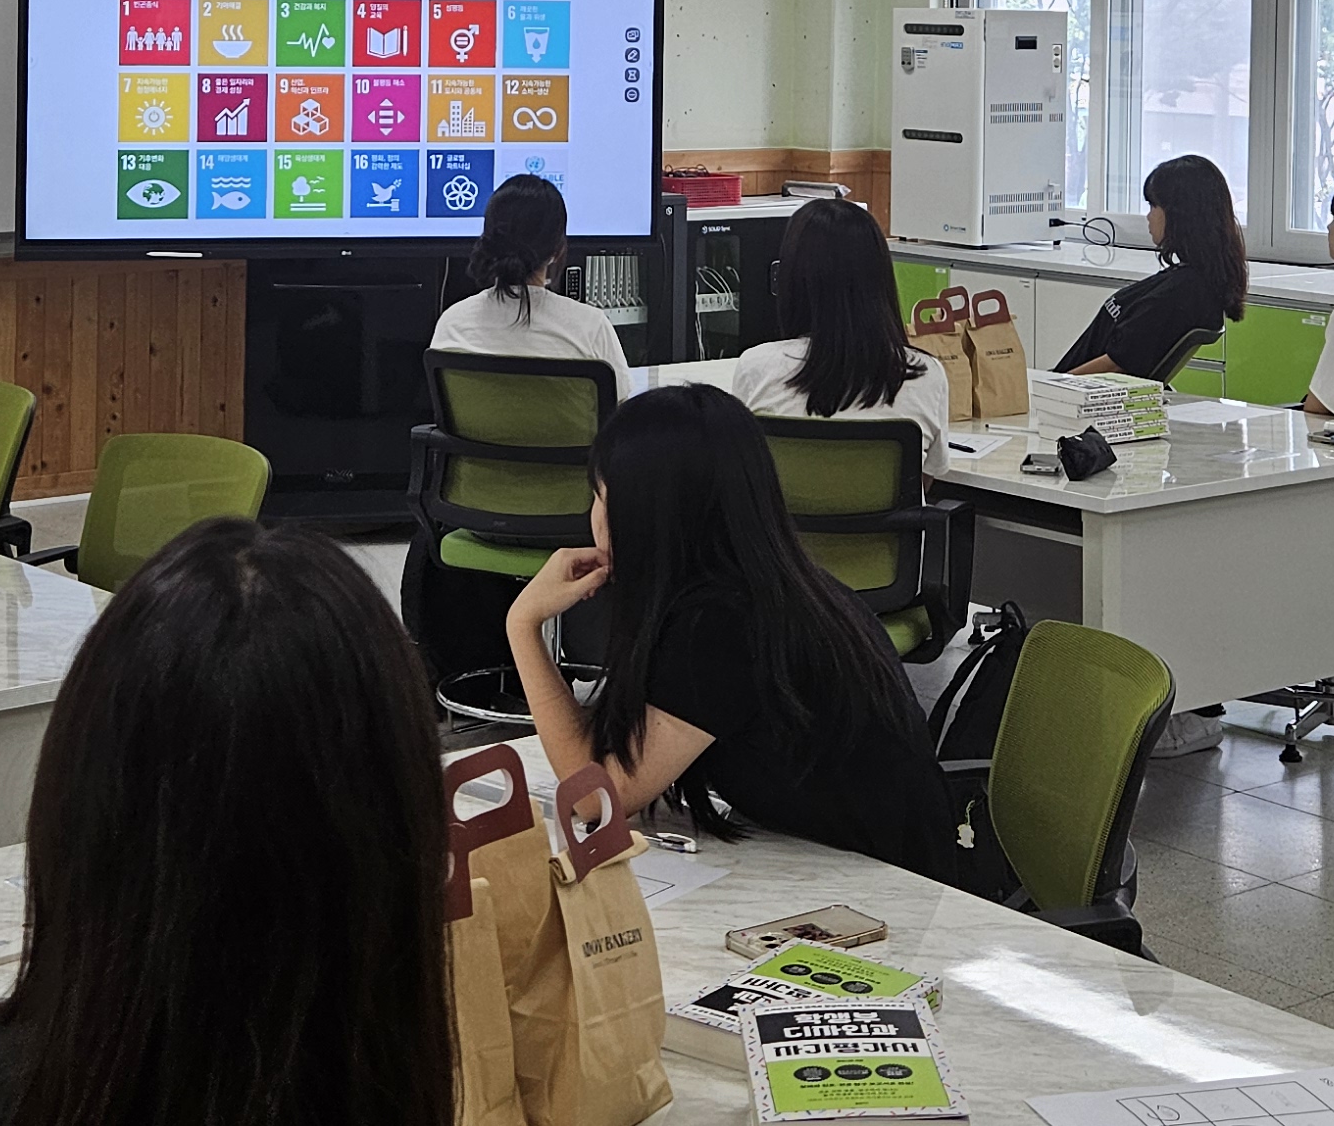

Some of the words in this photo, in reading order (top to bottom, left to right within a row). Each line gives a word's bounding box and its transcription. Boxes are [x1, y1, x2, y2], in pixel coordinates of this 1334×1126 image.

[122, 0, 130, 16] 1
[203, 1, 212, 17] 2
[280, 2, 290, 18] 3
[356, 3, 367, 19] 4
[433, 4, 442, 20] 5
[507, 5, 516, 20] 6
[123, 78, 132, 93] 7
[202, 78, 211, 93] 8
[279, 78, 289, 94] 9
[355, 79, 370, 94] 10
[431, 79, 442, 94] 11
[505, 80, 519, 95] 12
[121, 154, 136, 170] 13
[199, 155, 214, 170] 14
[277, 154, 292, 170] 15
[353, 154, 368, 170] 16
[430, 154, 444, 169] 17
[794, 1011, 881, 1024] 학생부
[783, 1024, 899, 1038] 디자인과
[774, 1042, 919, 1057] 자기평가서
